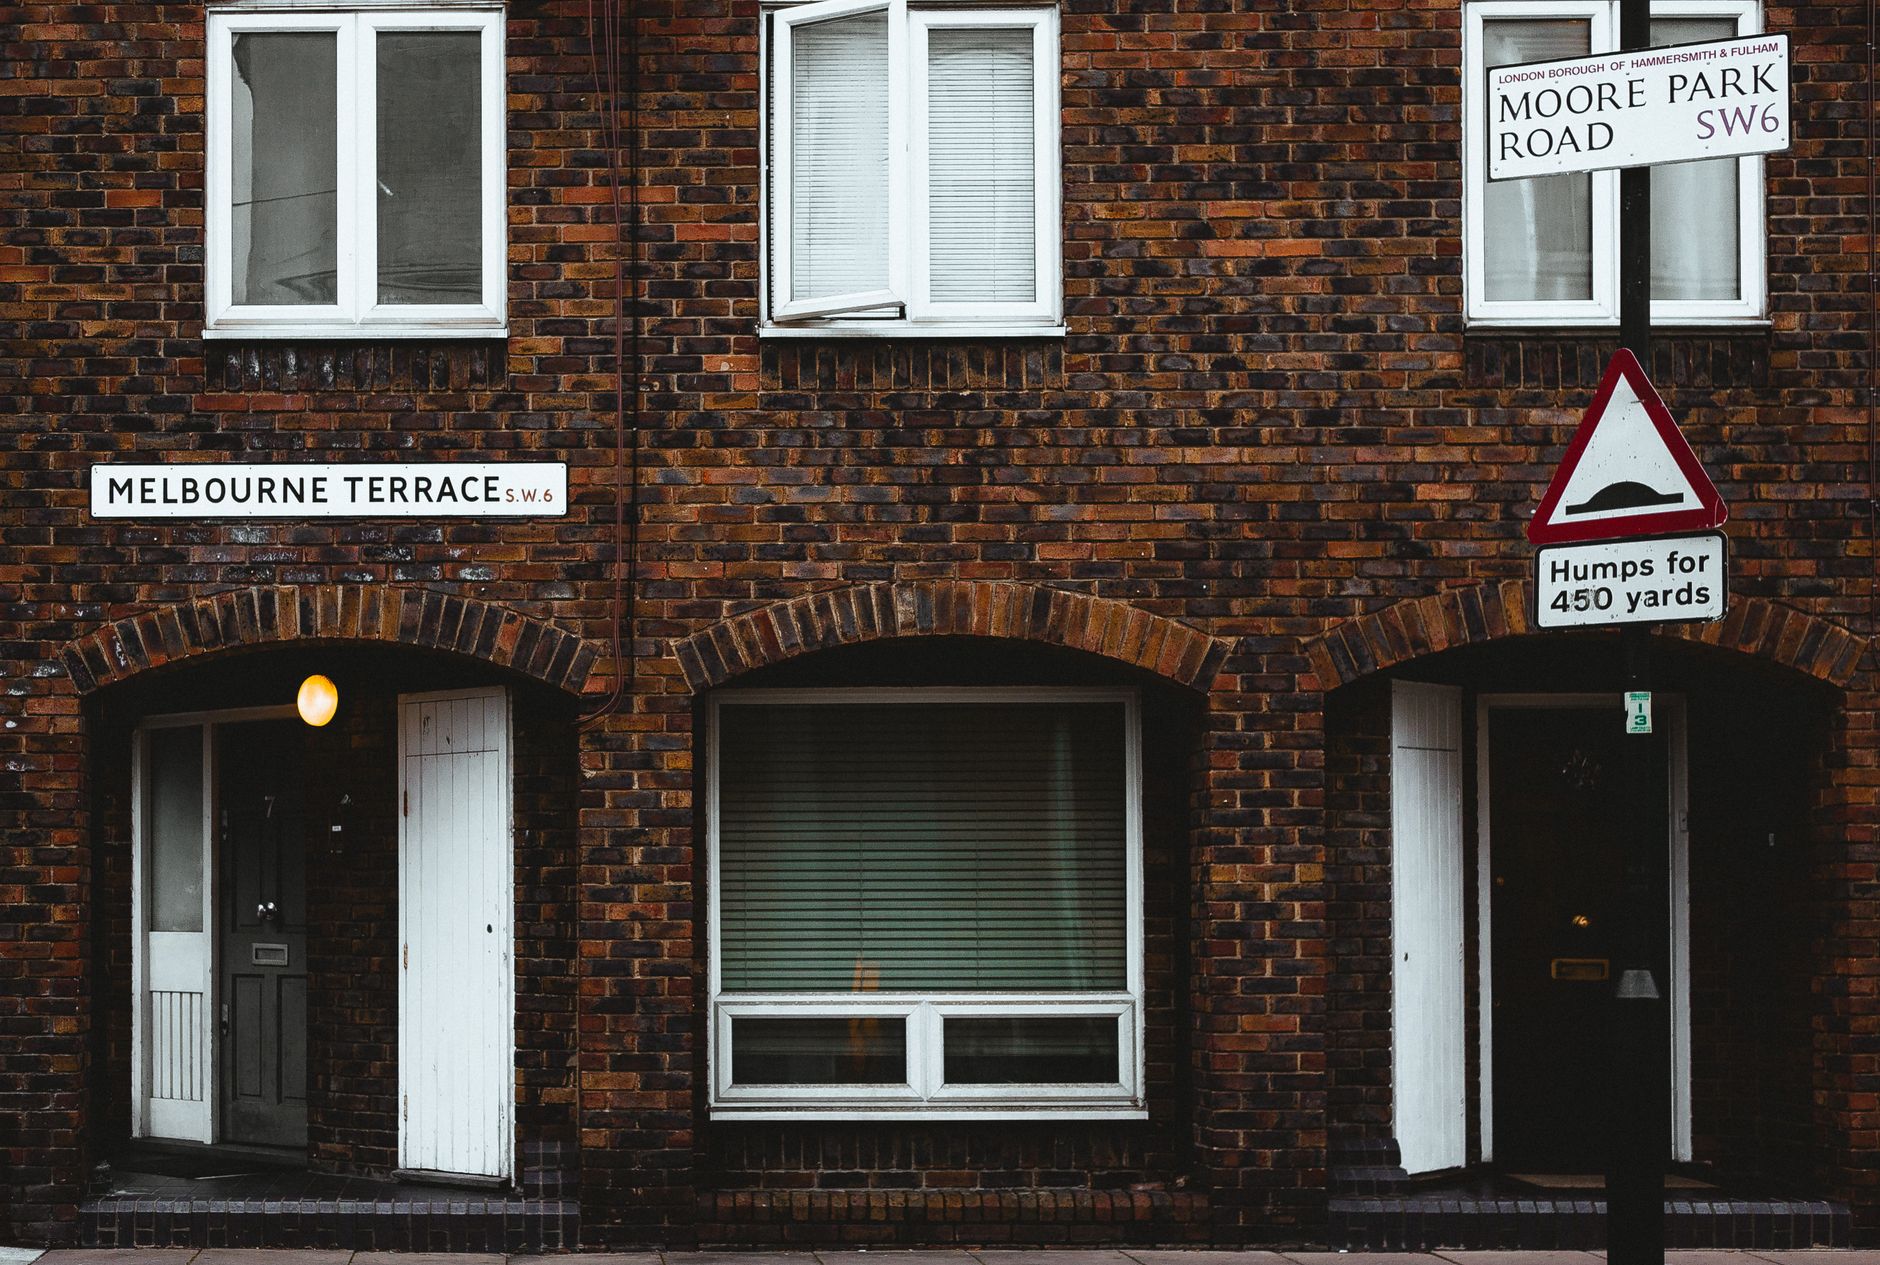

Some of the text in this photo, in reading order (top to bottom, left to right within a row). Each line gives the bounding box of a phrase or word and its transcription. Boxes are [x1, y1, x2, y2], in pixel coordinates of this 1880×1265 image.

[1499, 42, 1779, 84] LONDON BOROUGH OF HAMMERSMITH & FULHAM
[1499, 63, 1778, 122] MOORE PARK
[1499, 102, 1780, 161] ROAD SW6
[108, 476, 553, 504] MELBOURNE TERRACE S.W.6
[1551, 551, 1710, 582] Humps for
[1550, 582, 1711, 613] 450 yards
